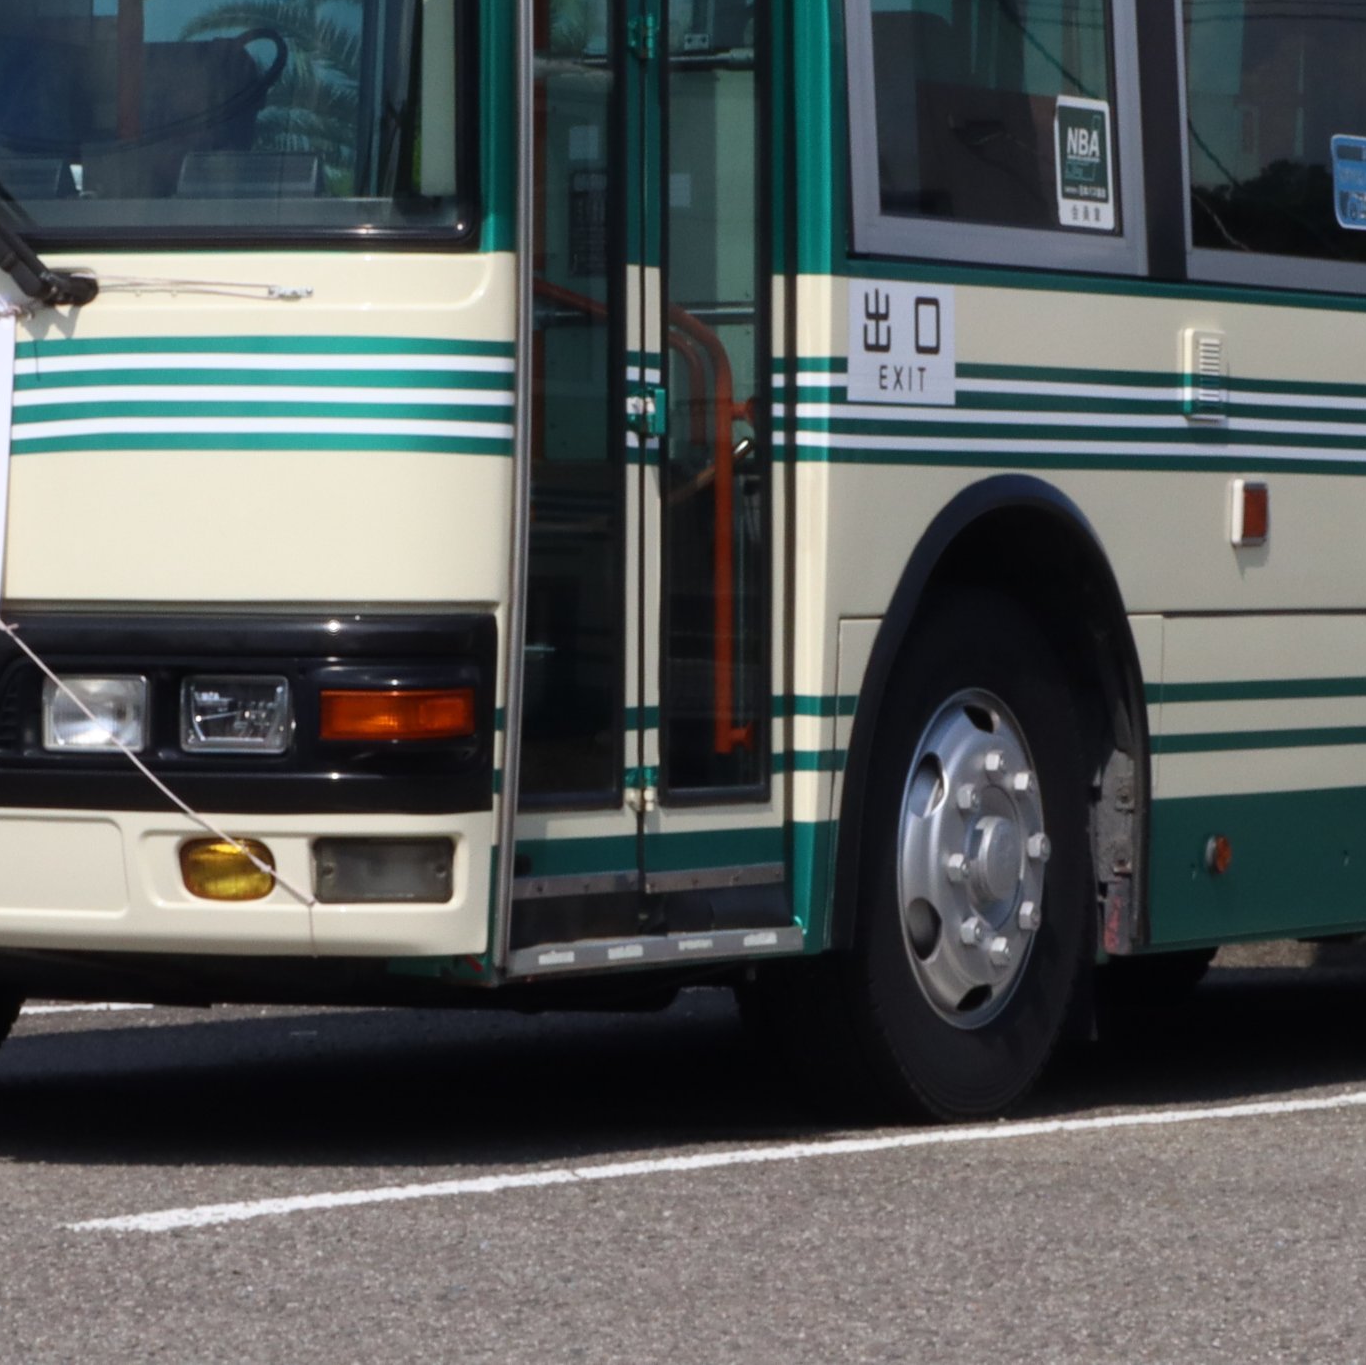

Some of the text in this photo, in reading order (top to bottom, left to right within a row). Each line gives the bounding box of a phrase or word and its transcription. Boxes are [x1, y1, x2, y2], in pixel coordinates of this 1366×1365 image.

[1066, 127, 1099, 157] NBA
[862, 287, 940, 355] 出口
[878, 364, 927, 392] EXIT
